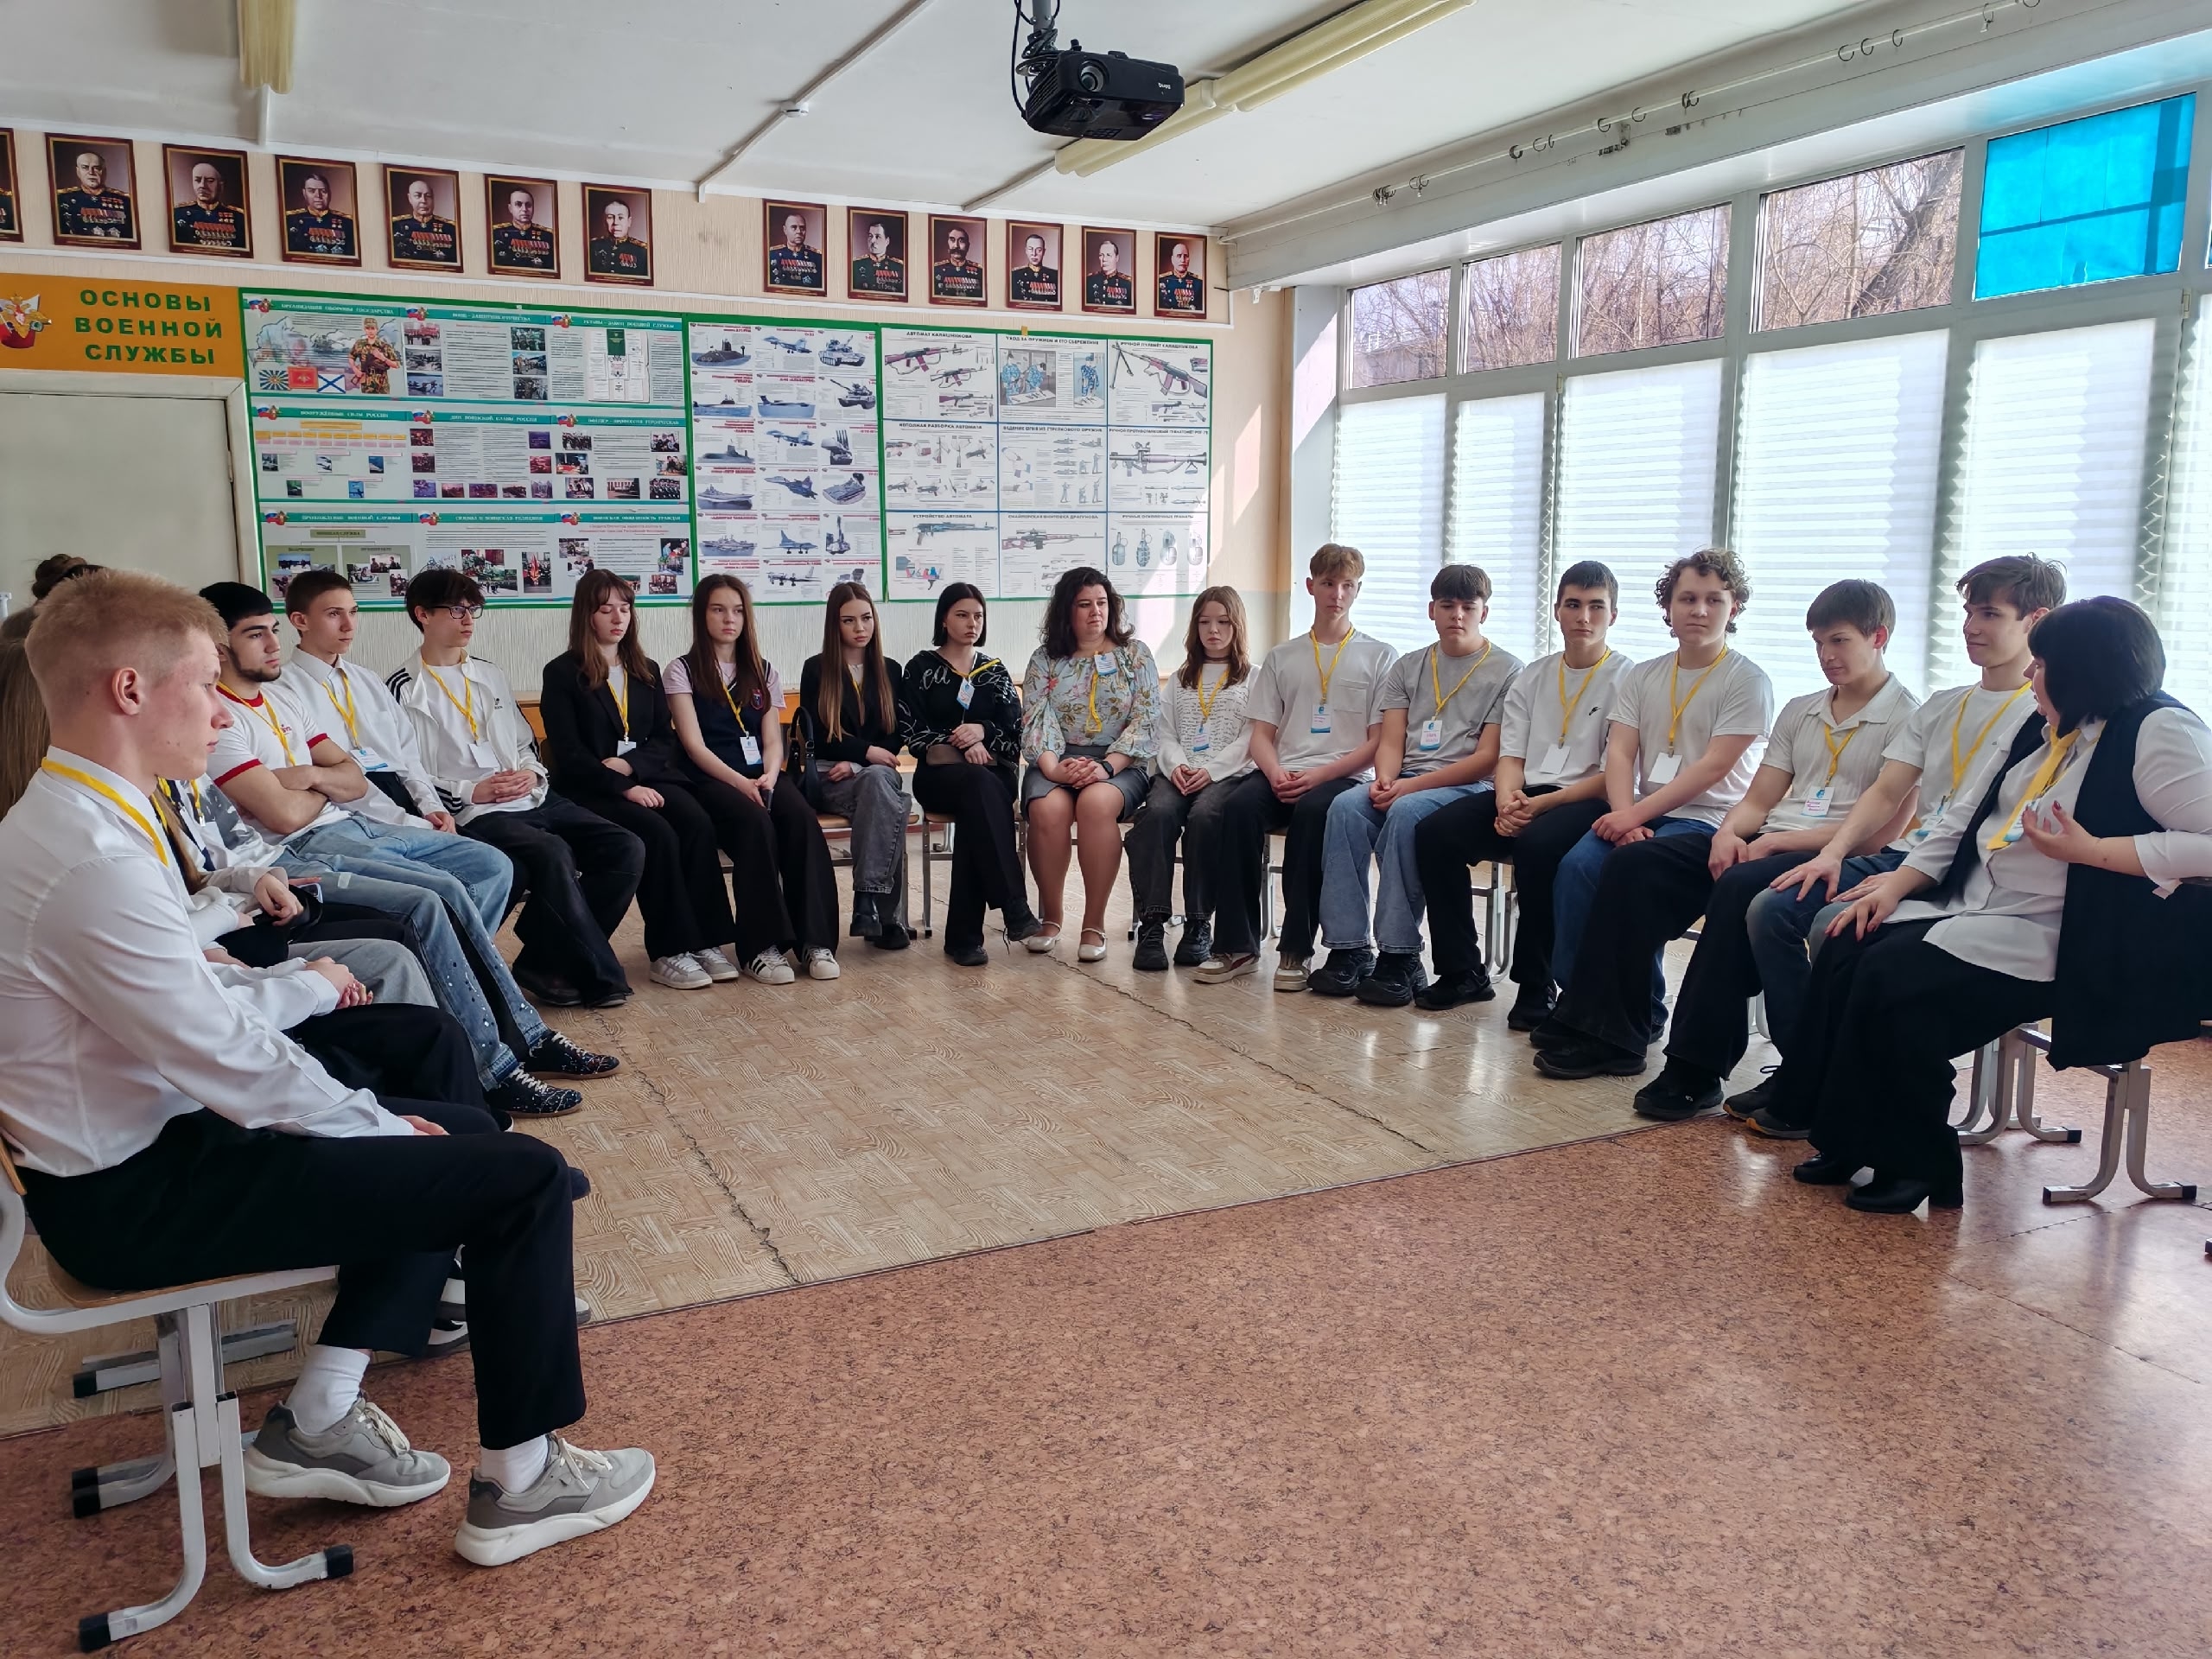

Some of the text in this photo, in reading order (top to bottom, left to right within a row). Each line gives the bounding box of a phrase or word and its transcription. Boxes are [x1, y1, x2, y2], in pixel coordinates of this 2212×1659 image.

[79, 289, 210, 312] ОСНОВЫ
[75, 317, 222, 338] ВОЕННОЙ
[85, 344, 214, 365] СЛУЖБЫ
